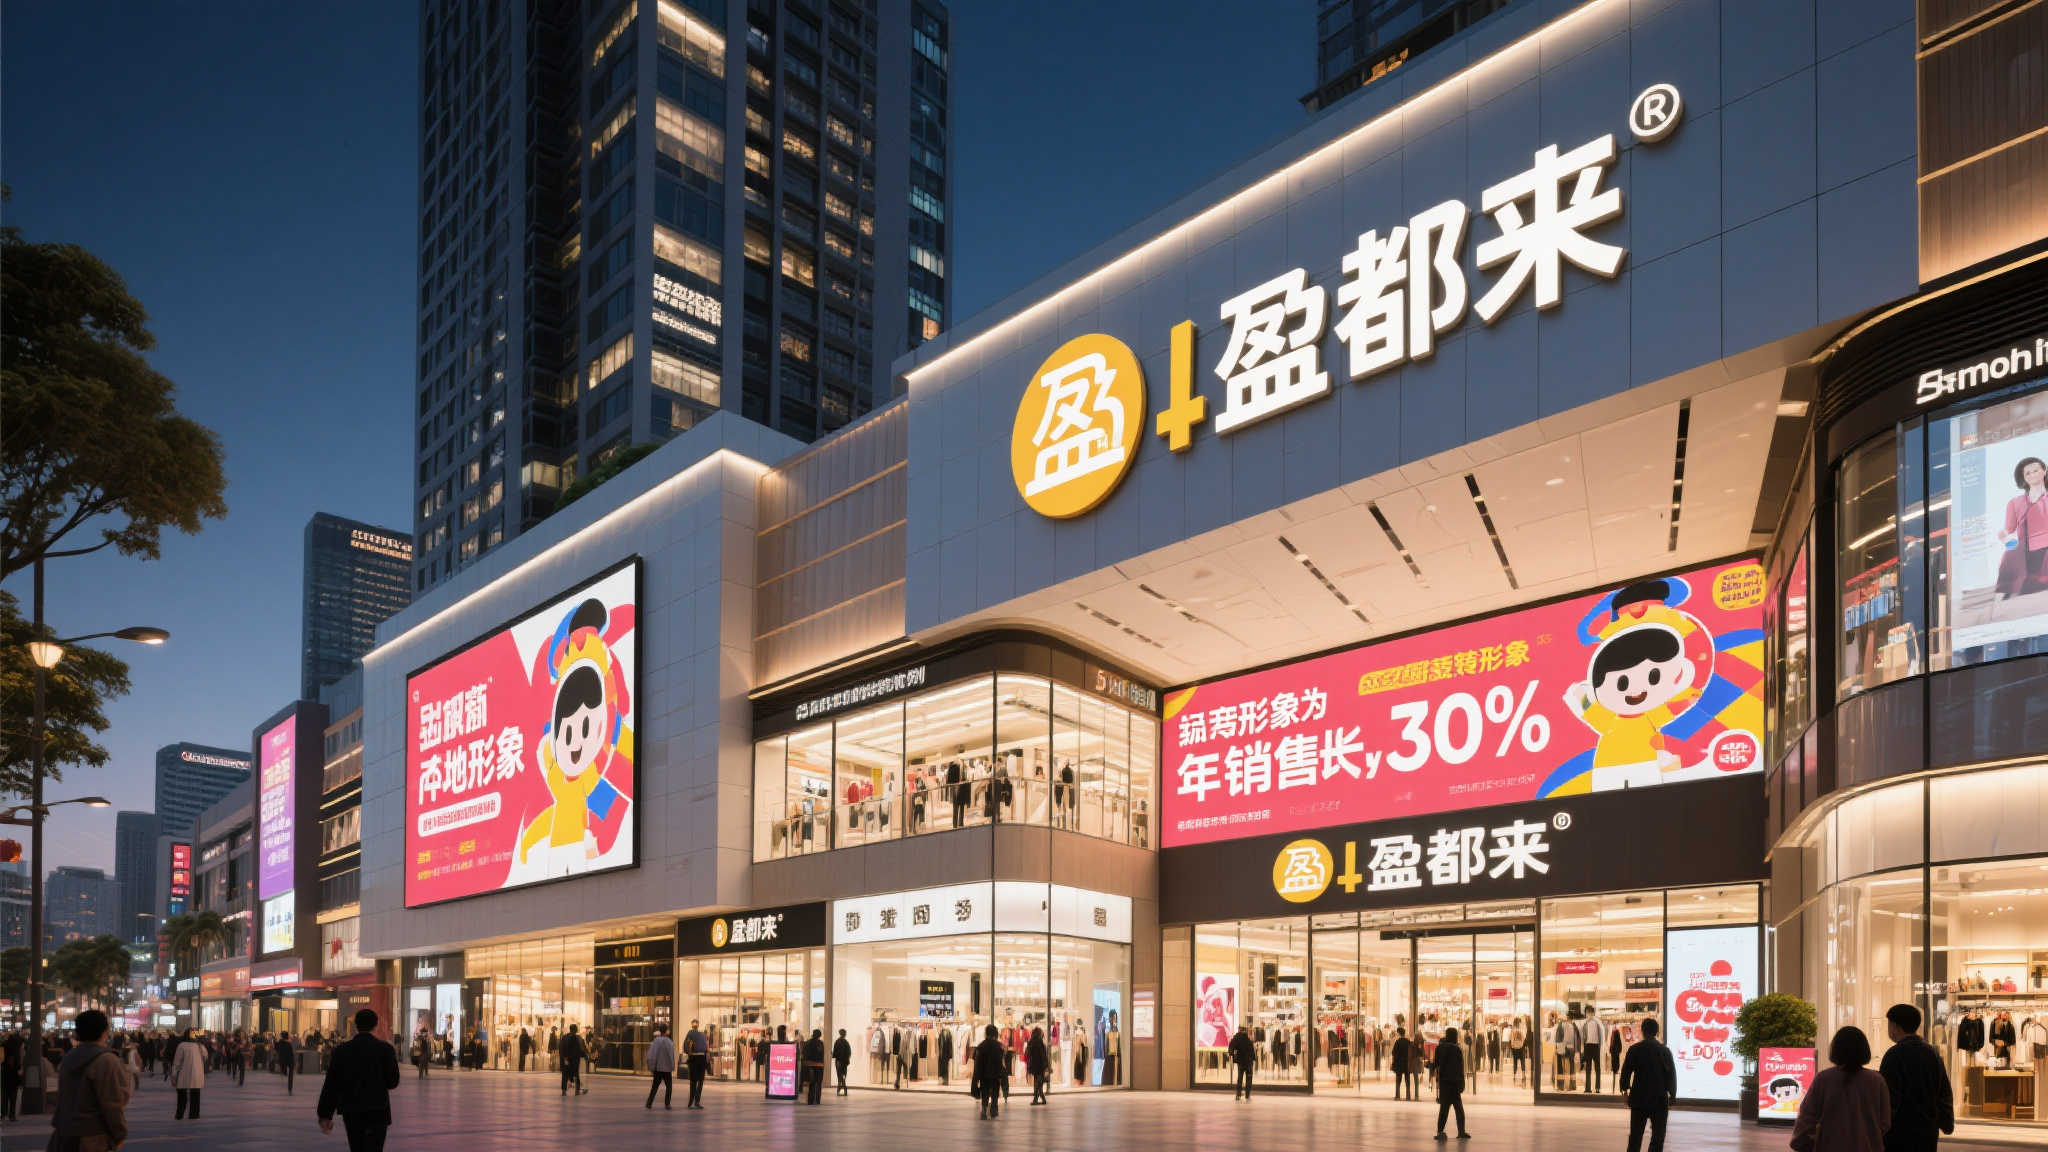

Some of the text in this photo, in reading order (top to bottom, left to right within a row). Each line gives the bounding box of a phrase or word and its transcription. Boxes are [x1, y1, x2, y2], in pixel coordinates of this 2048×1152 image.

[1214, 132, 1628, 436] 盈都来
[1386, 680, 1551, 773] 30%
[1367, 819, 1550, 892] 盈都来
